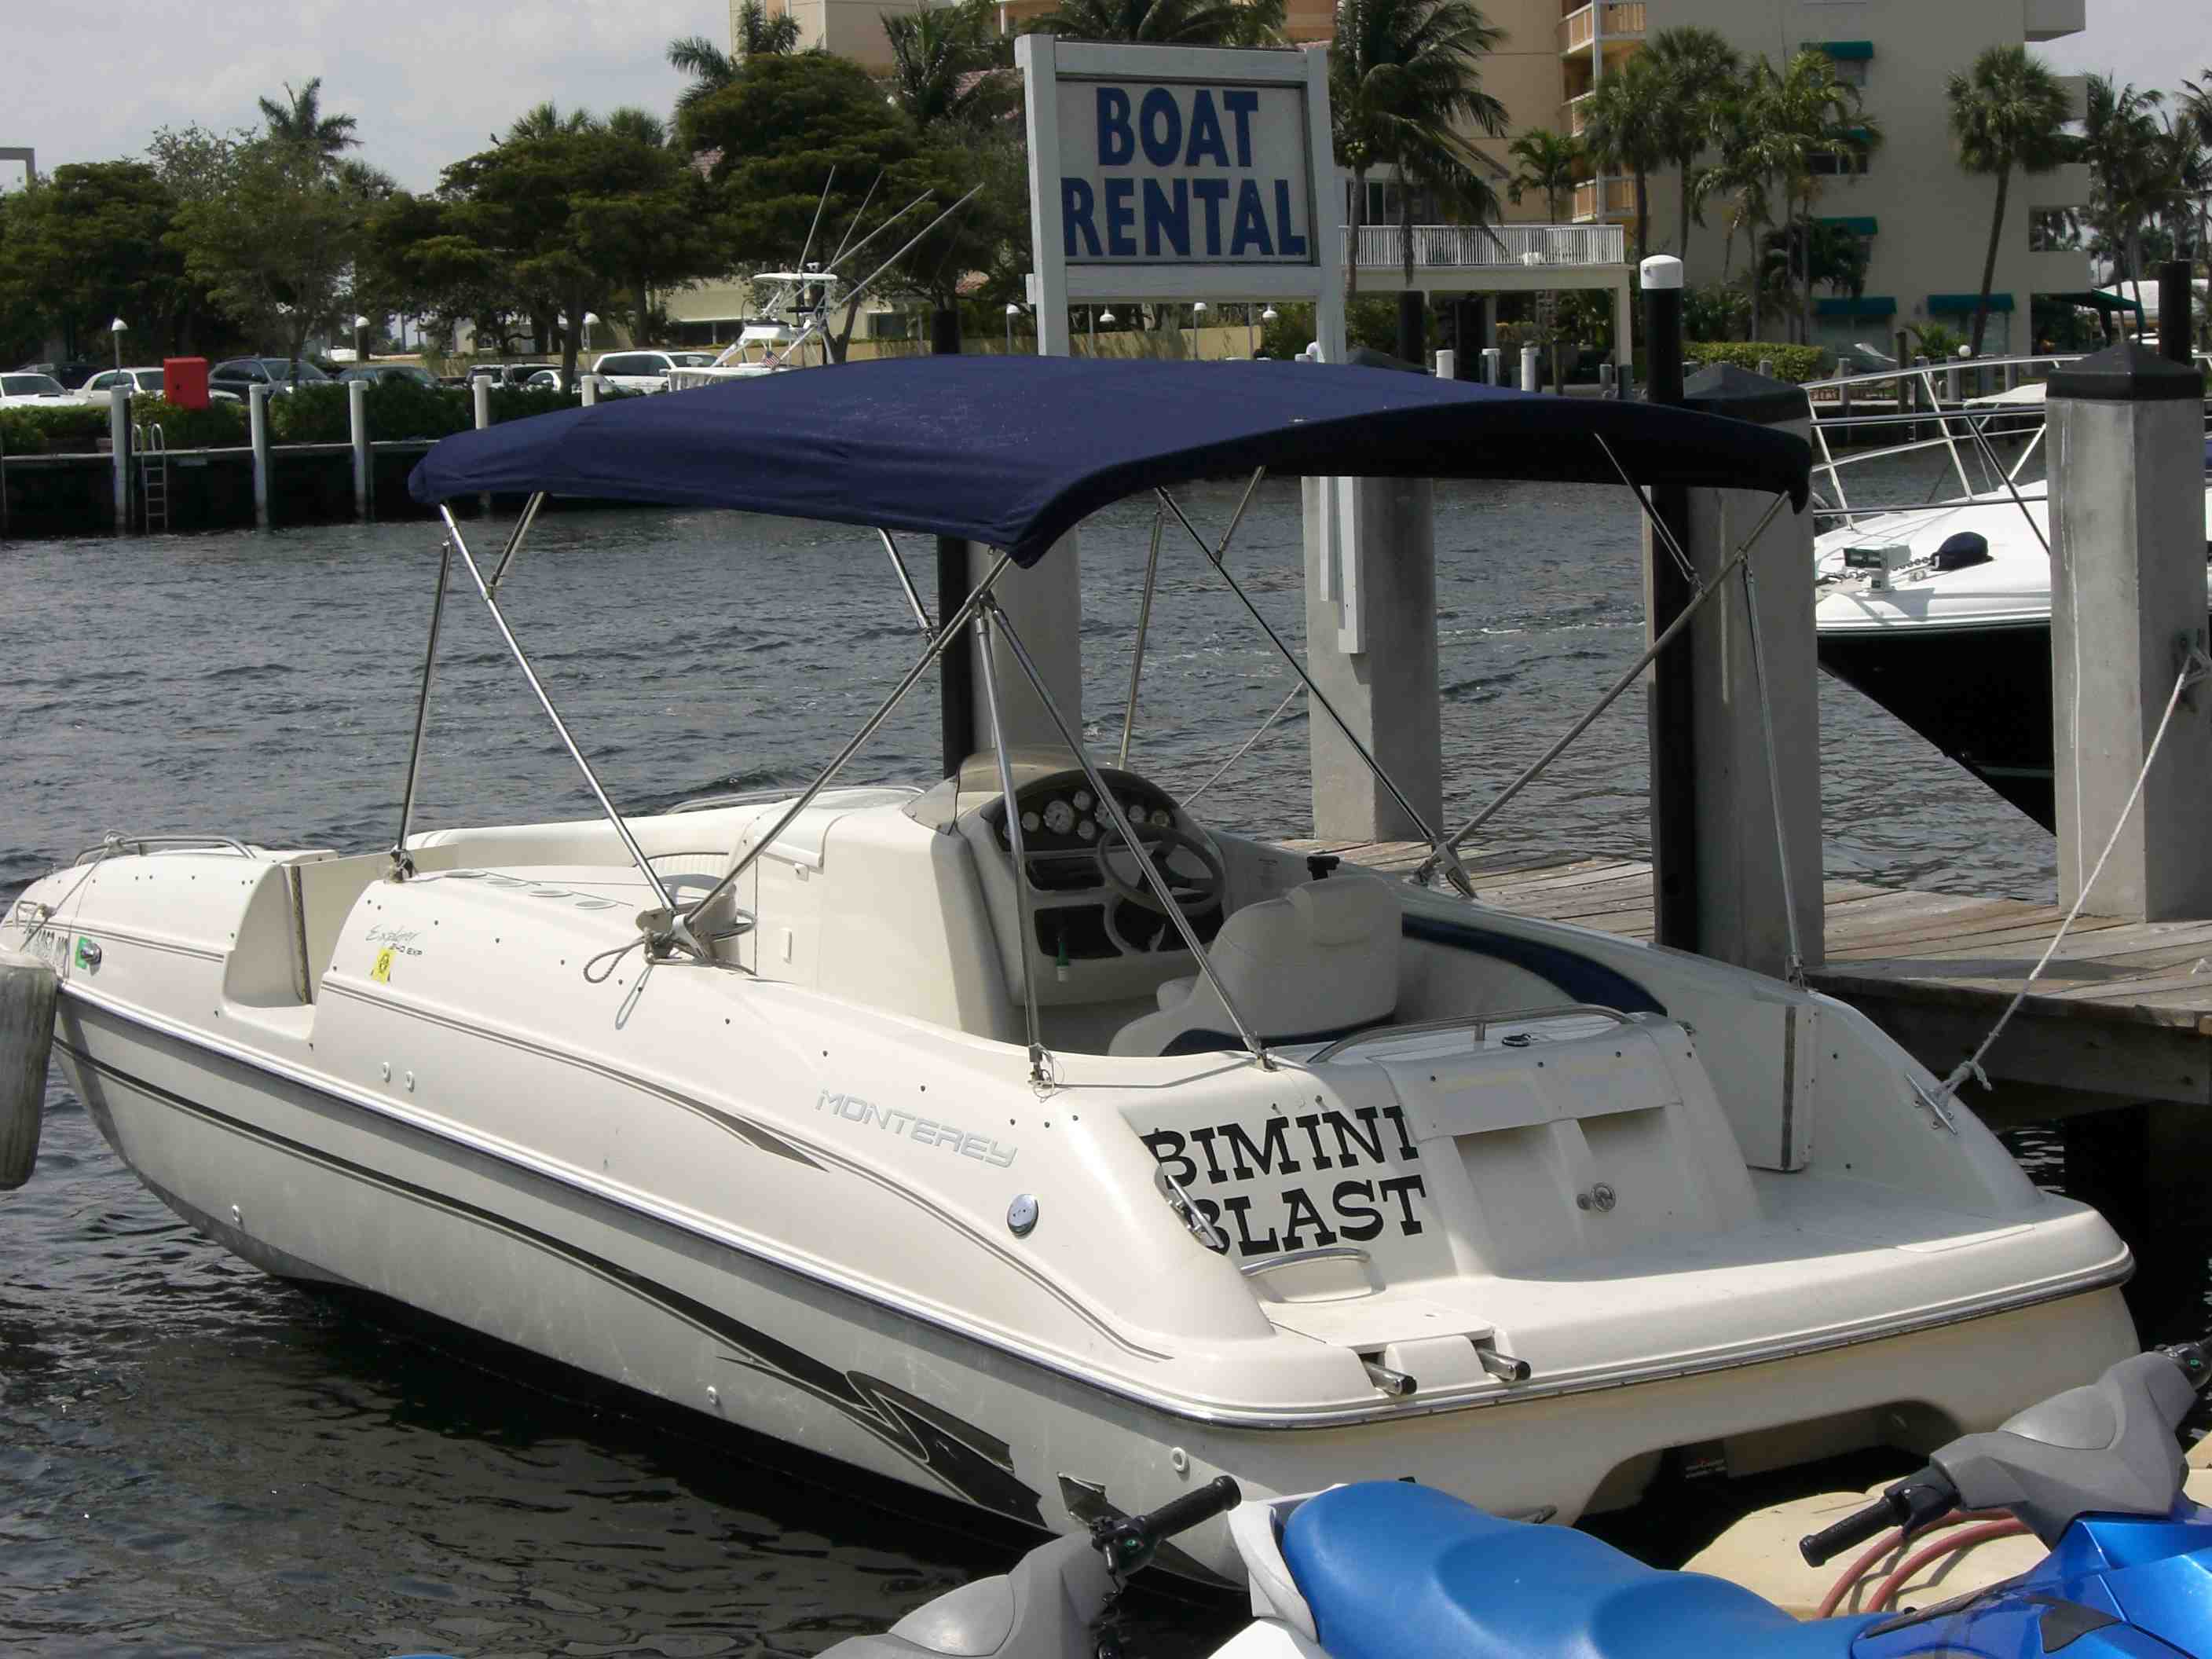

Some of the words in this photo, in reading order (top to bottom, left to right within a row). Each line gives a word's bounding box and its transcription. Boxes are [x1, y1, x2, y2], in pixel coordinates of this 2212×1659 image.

[1096, 87, 1258, 167] BOAT
[1060, 177, 1306, 257] RENTAL
[815, 1088, 1018, 1169] MONTEREY
[1140, 1105, 1419, 1190] BIMINI
